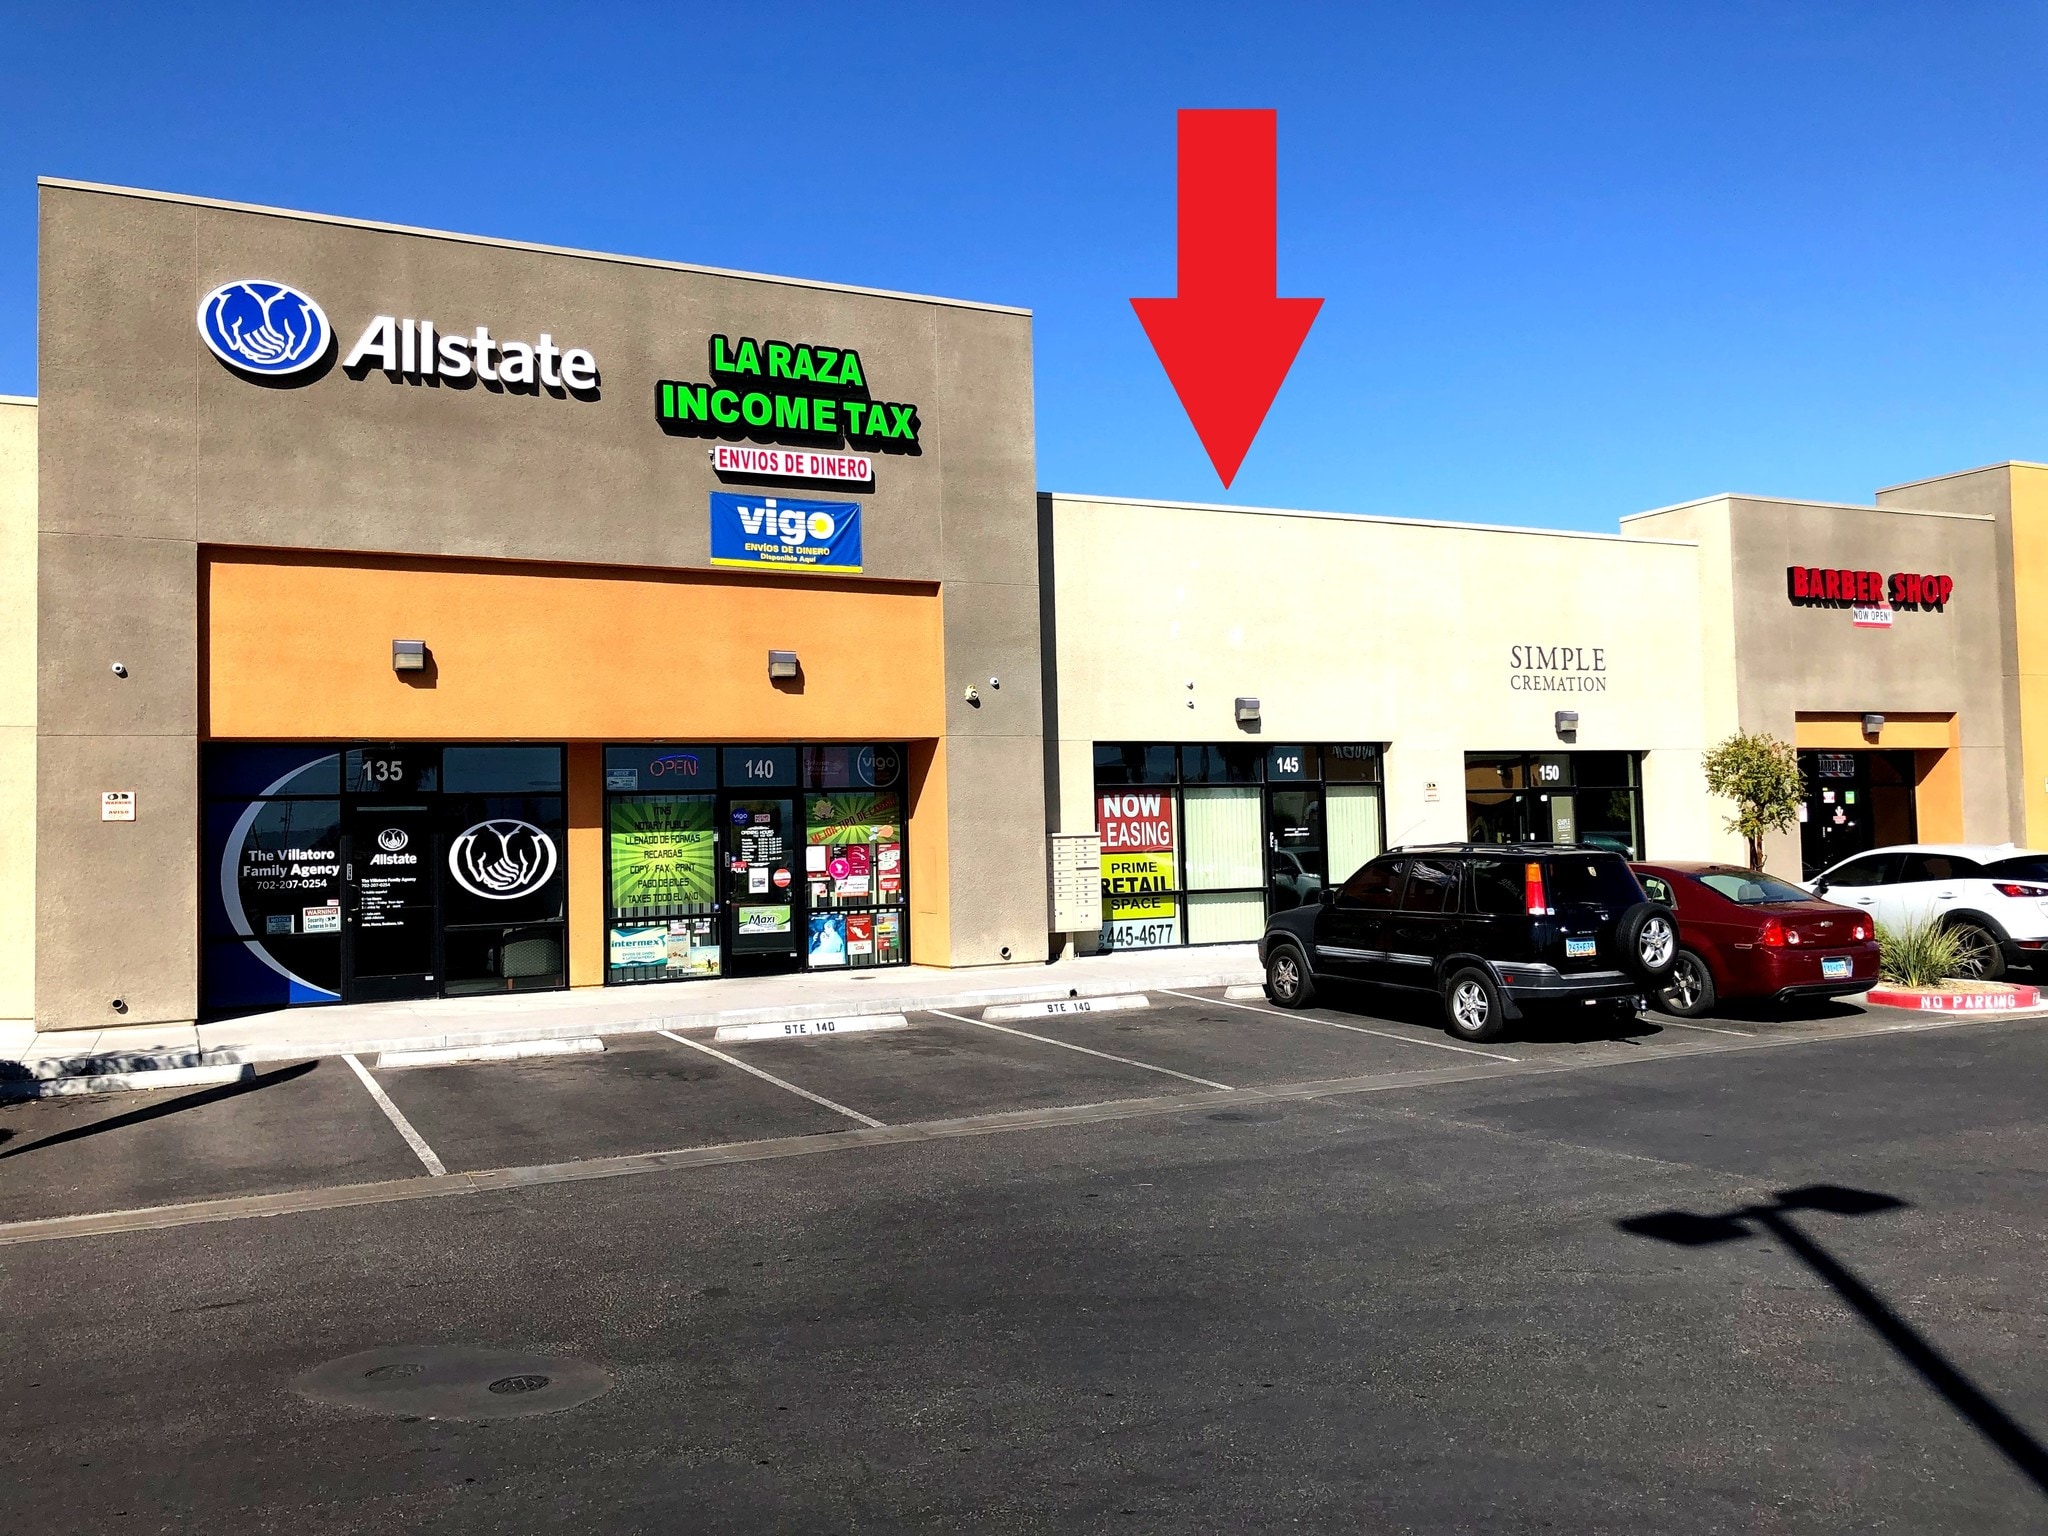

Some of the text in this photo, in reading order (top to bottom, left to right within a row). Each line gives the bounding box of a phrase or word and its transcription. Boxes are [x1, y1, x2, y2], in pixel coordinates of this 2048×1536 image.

[342, 315, 597, 391] Allstate
[713, 337, 864, 387] LA RAZA
[662, 384, 915, 440] INCOME TAX
[718, 448, 868, 479] ENVIOS DE DINERO
[736, 498, 836, 546] vigo
[760, 552, 798, 562] Disponible
[781, 545, 794, 554] DE
[796, 546, 831, 556] DINERO
[1787, 566, 1953, 605] BARBER SHOP
[1853, 609, 1870, 620] NOW
[1510, 645, 1607, 672] SIMPLE
[1510, 674, 1607, 692] CREMATION
[649, 759, 698, 777] OPEN
[745, 759, 774, 779] 140
[862, 753, 896, 771] vigo
[1276, 756, 1300, 773] 145
[362, 760, 403, 782] 135
[1539, 765, 1560, 781] 150
[1103, 794, 1161, 818] NOW
[733, 812, 748, 820] vigo
[634, 820, 690, 831] NOTARY PUBLIC
[625, 834, 701, 846] LLENADO DE FORMAS
[248, 848, 335, 862] The Villatoro
[369, 853, 418, 866] Allstate
[644, 849, 683, 859] RECARGAS
[243, 863, 340, 878] Family Agency
[630, 863, 696, 875] COPY FAX PRINT
[1111, 861, 1158, 874] PRIME
[256, 878, 328, 890] 702-207-0254
[628, 894, 652, 904] TAXES
[653, 893, 672, 903] TODO
[674, 892, 683, 901] EL
[1111, 897, 1161, 911] SPACE
[305, 908, 338, 916] WARNING
[749, 914, 776, 925] Maxi
[1107, 923, 1174, 947] 445-4677
[611, 938, 660, 949] intermex
[1047, 1001, 1091, 1013] STE 140
[1921, 996, 1943, 1009] NO
[1953, 994, 2016, 1010] PARKING
[784, 1021, 835, 1034] STE 140
